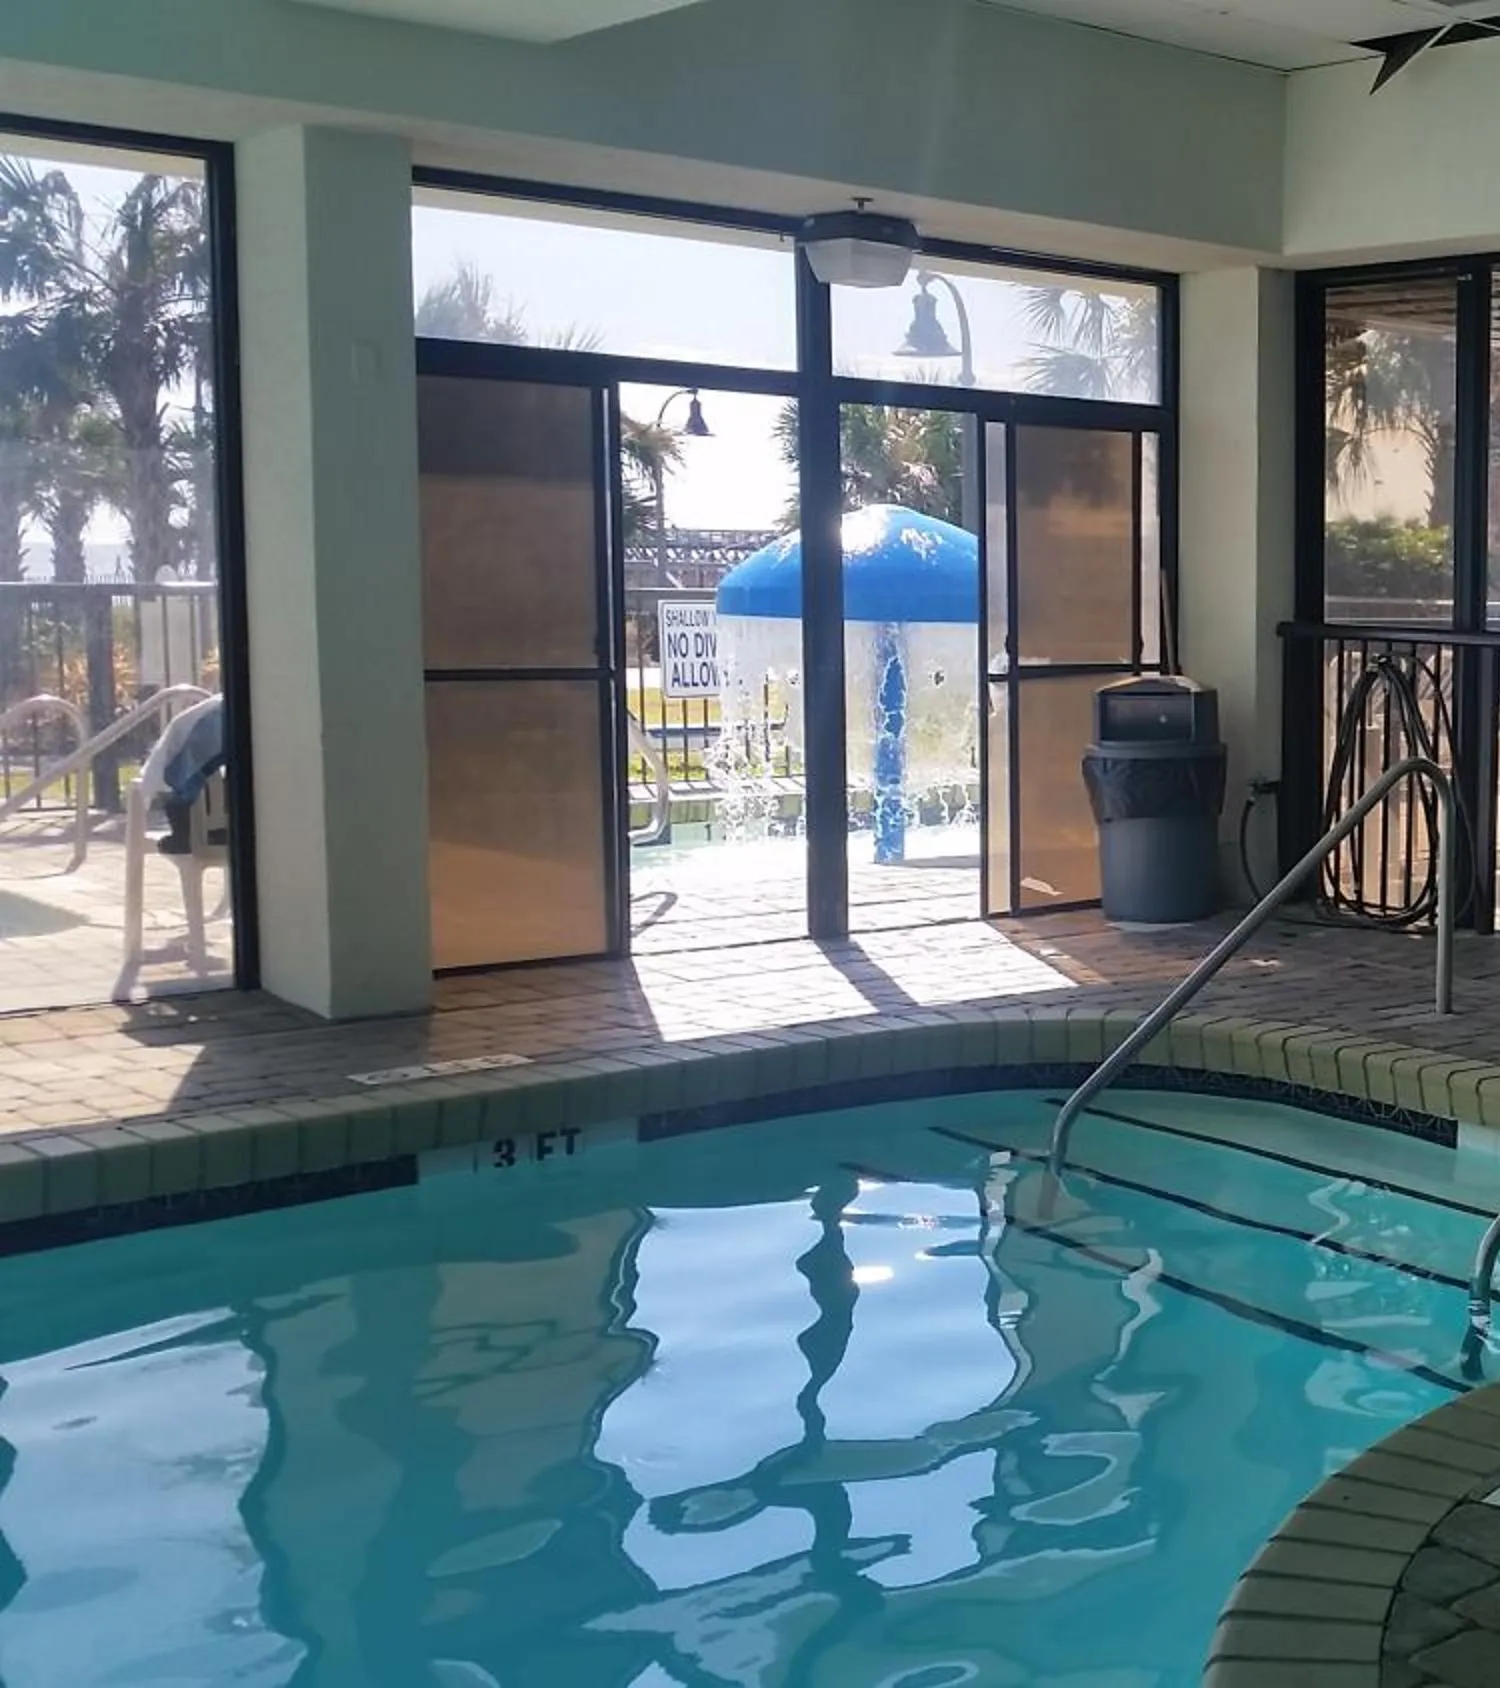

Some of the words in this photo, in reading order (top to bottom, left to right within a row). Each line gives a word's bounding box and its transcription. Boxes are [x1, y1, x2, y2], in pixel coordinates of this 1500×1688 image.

[666, 609, 709, 627] SHALLOW
[667, 632, 688, 658] NO
[694, 632, 717, 658] DIV
[493, 1137, 515, 1168] 3
[537, 1127, 582, 1161] FT
